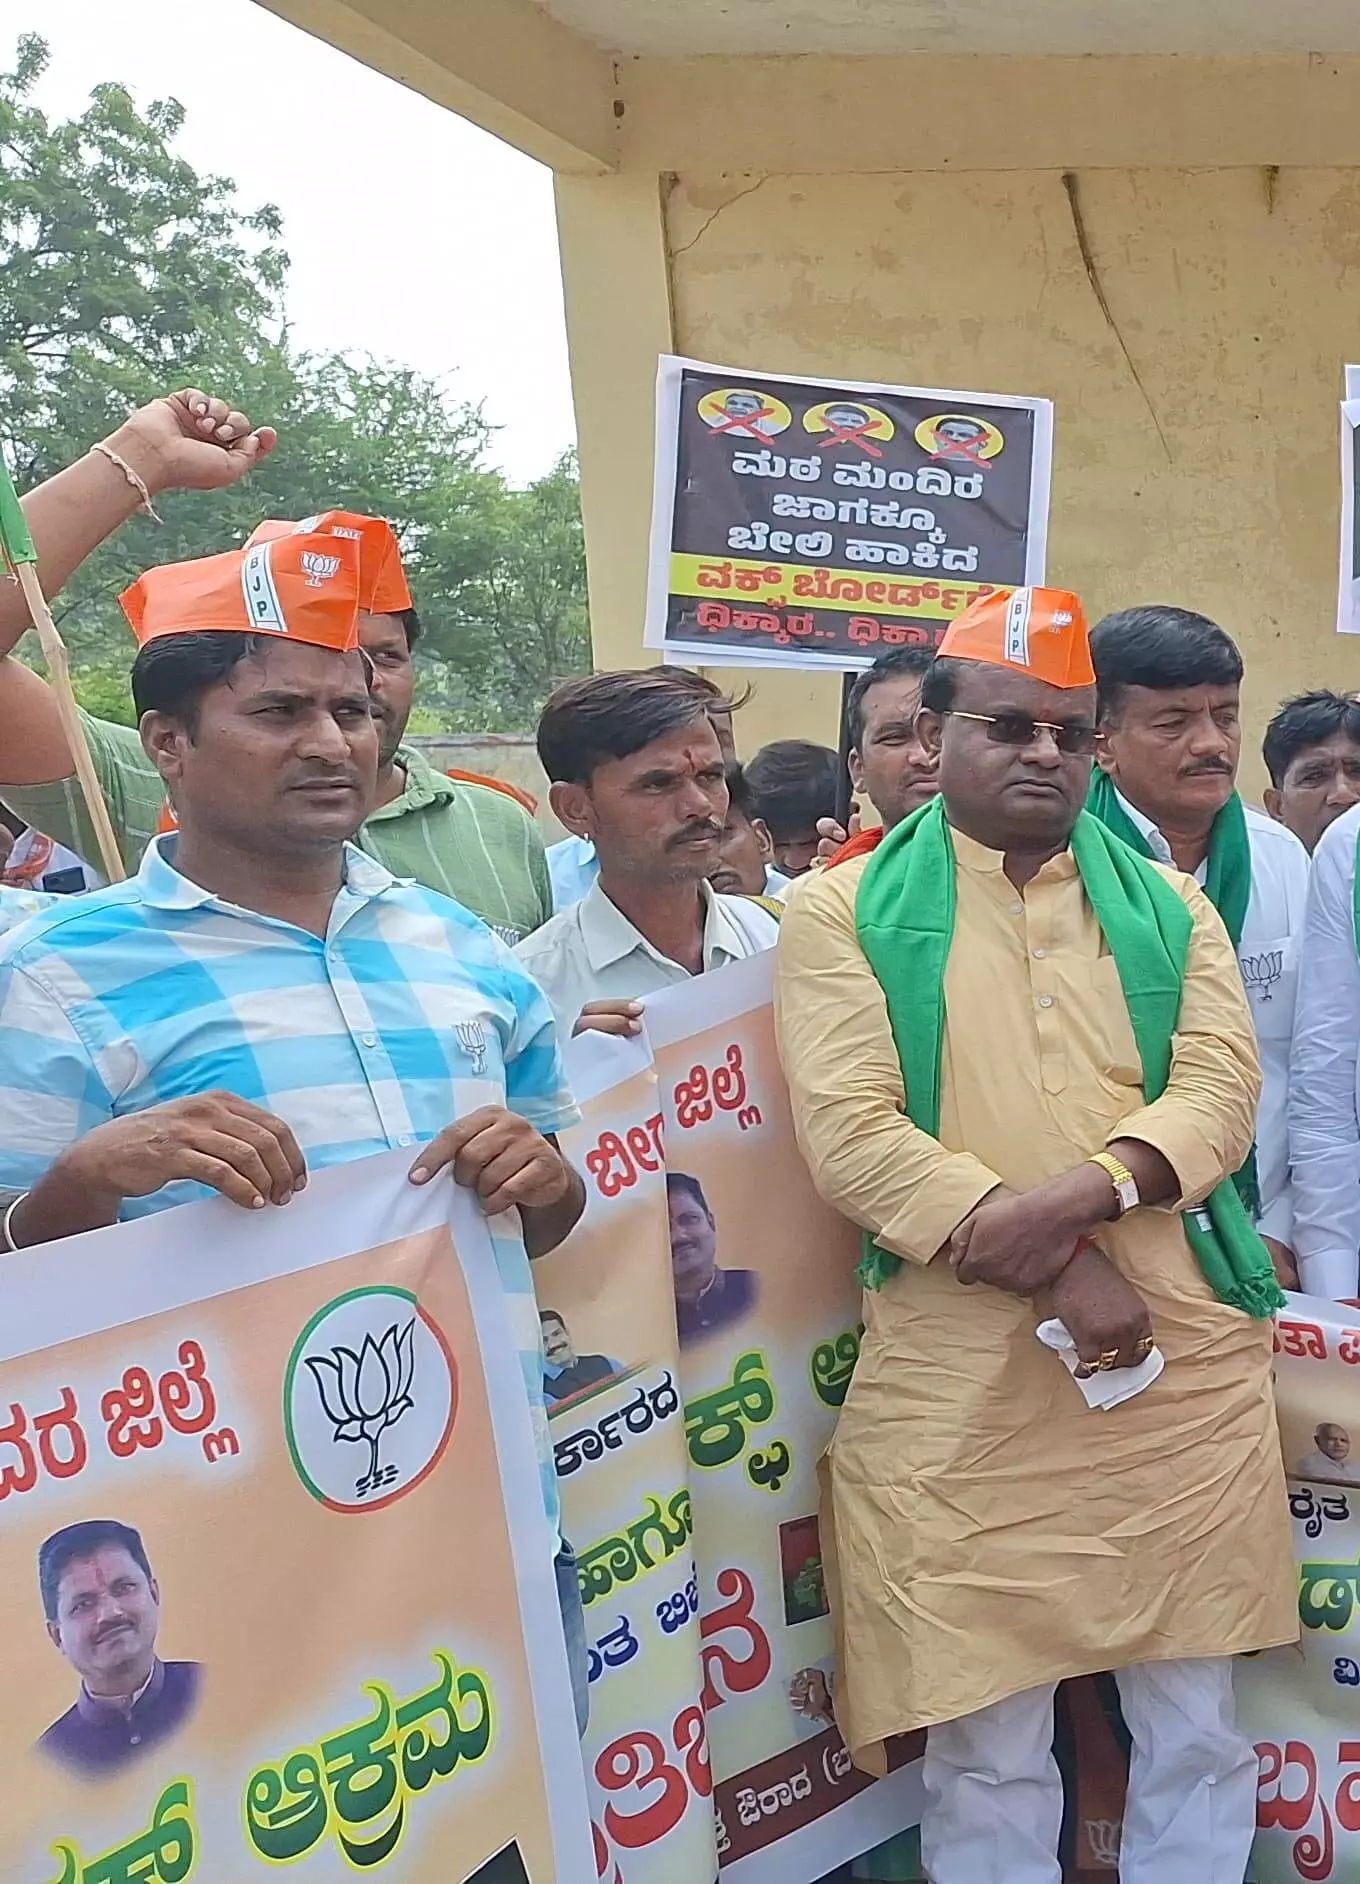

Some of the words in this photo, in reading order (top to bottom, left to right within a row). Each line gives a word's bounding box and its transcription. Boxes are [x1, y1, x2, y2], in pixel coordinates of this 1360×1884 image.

[732, 449, 822, 483] ಮಠ
[833, 462, 984, 499] ಮಂದಿರ
[728, 522, 833, 558] ಬೇಲಿ
[846, 537, 979, 573] ಹಾಕಿದ
[674, 1044, 762, 1131] ಜಿಲ್ಲೆ
[100, 1340, 241, 1464] ಜಿಲ್ಲೆ
[554, 1370, 680, 1478] ರ್ಕಾರದ
[1289, 1490, 1350, 1539] ರೈತ
